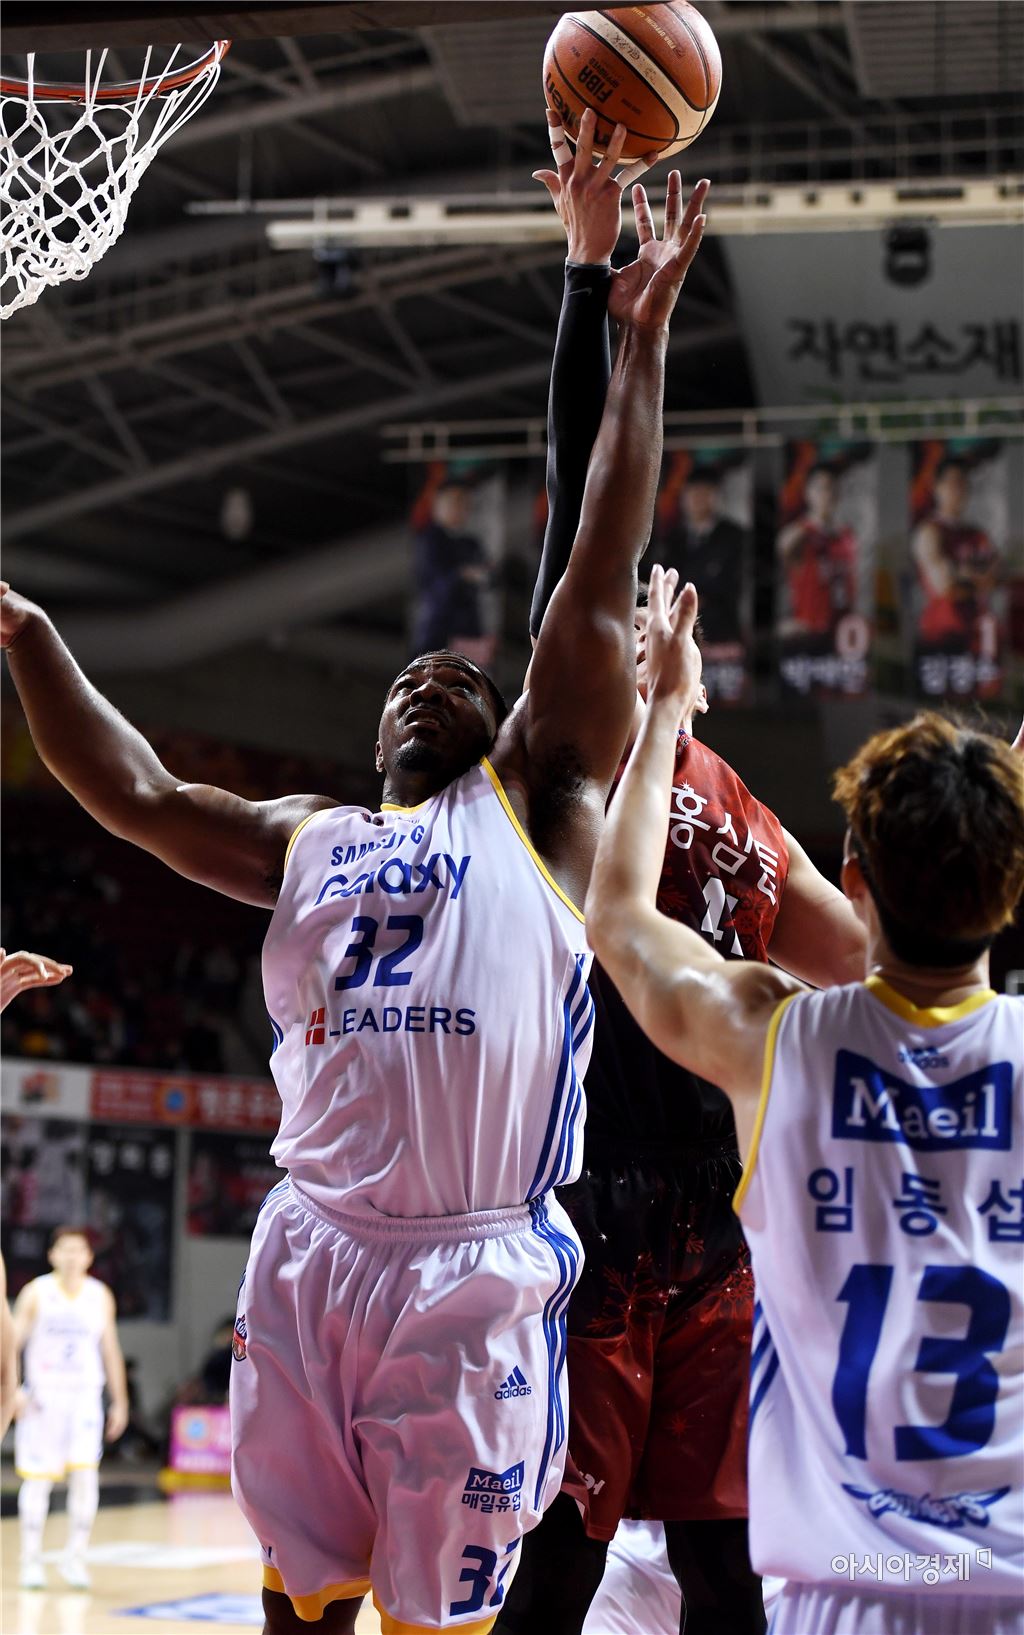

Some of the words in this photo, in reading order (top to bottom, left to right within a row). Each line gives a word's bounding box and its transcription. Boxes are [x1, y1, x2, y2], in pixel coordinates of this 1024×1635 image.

[577, 64, 615, 105] FIBA
[786, 317, 1020, 380] 자연소재
[331, 825, 425, 867] SAMUG
[334, 914, 425, 991] 32
[845, 1077, 1000, 1140] Maeil
[831, 1263, 1012, 1462] 13
[494, 1384, 533, 1401] adidas
[470, 1469, 521, 1491] Maeil
[461, 1491, 522, 1514] 매일유업
